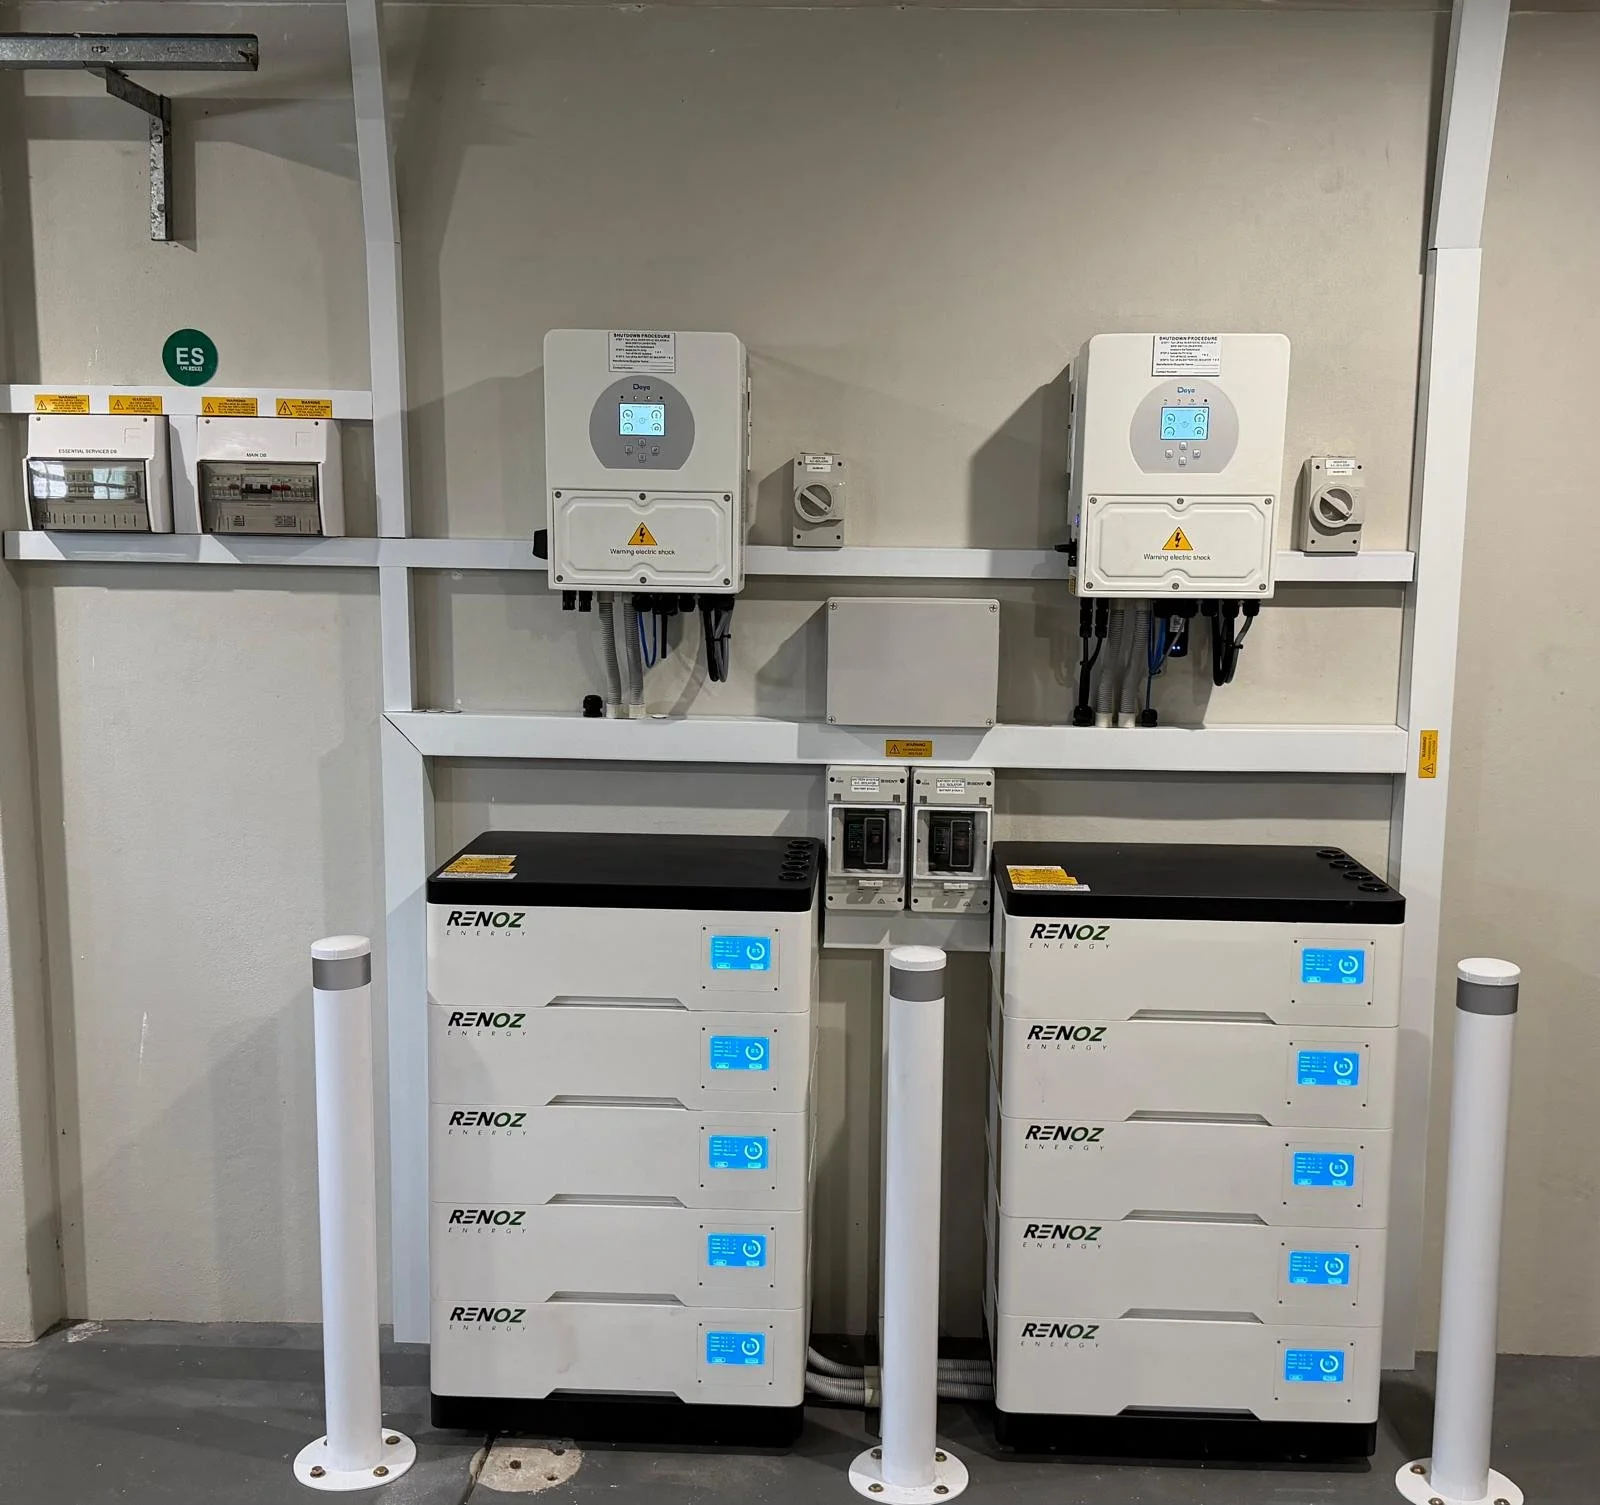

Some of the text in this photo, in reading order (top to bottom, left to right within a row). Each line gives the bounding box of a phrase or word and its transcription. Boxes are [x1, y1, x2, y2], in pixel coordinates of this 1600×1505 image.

[176, 347, 205, 366] ES
[1143, 553, 1169, 561] Warning
[447, 911, 526, 928] RENOZ
[1030, 923, 1110, 940] RENOZ
[448, 1012, 526, 1028] RENOZ
[1028, 1025, 1107, 1041] RENOZ
[449, 1111, 527, 1128] RENOZ
[1025, 1125, 1105, 1142] RENOZ
[449, 1209, 527, 1226] RENOZ
[1024, 1224, 1102, 1240] RENOZ
[450, 1307, 527, 1323] RENOZ
[1022, 1323, 1100, 1339] RENOZ
